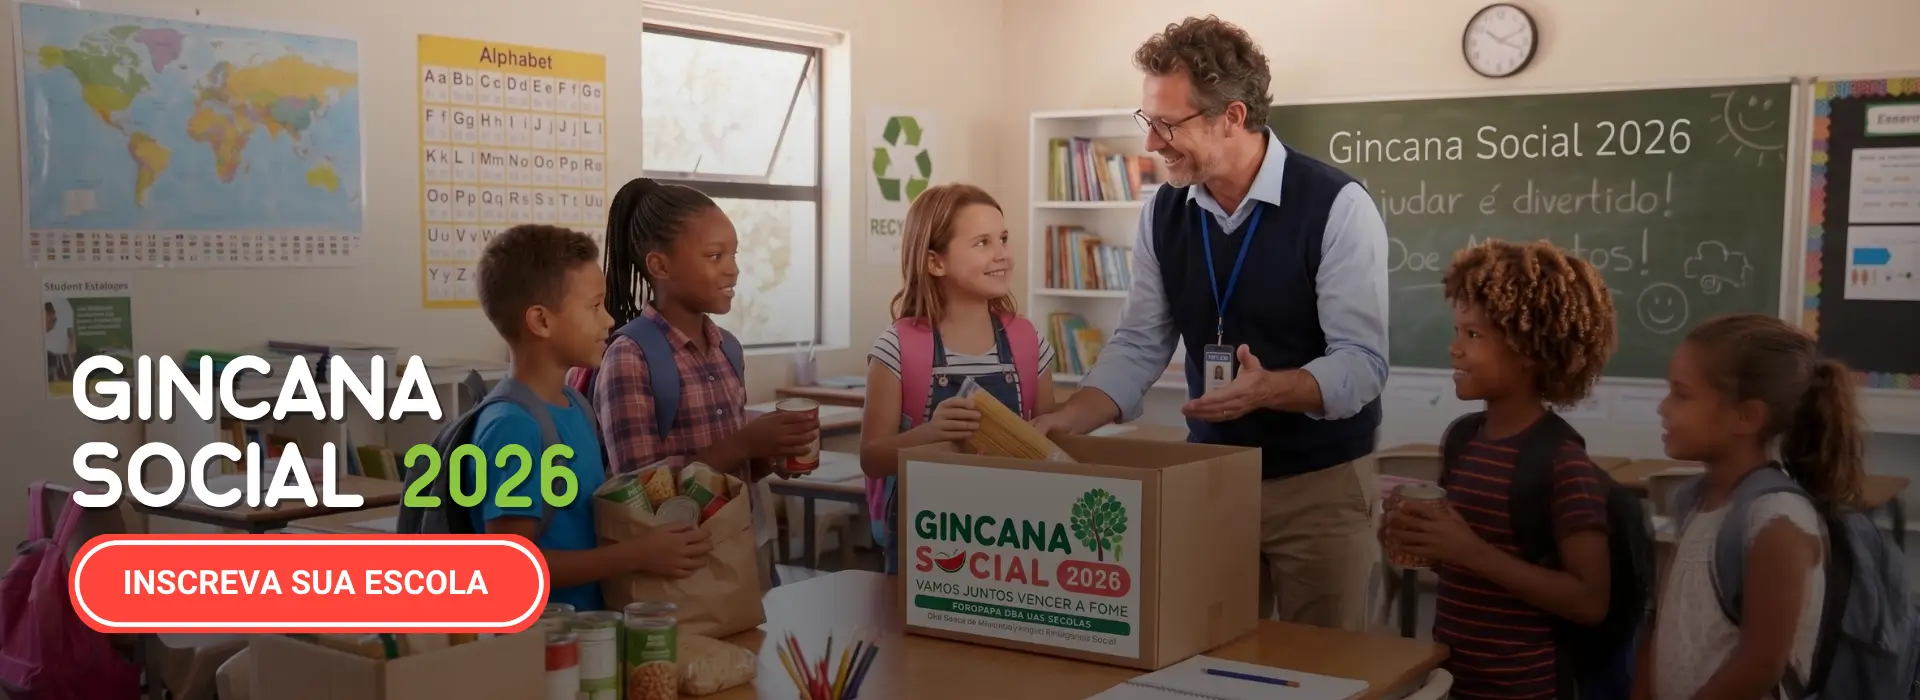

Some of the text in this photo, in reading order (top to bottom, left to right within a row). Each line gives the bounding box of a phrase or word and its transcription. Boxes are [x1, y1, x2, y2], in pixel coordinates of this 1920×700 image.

[480, 46, 552, 70] Alphabet
[1330, 118, 1692, 163] Gincana Social 2026
[1364, 172, 1674, 222] judar é divertido!
[44, 282, 82, 291] Student
[915, 509, 1072, 555] GINCANA
[1066, 566, 1121, 590] 2026
[916, 579, 1128, 618] VAMOS JUNTOS VENCER A FOME
[952, 602, 1002, 617] FOROPAPA
[1004, 609, 1024, 620] DBA
[1048, 615, 1092, 629] SECOLAS
